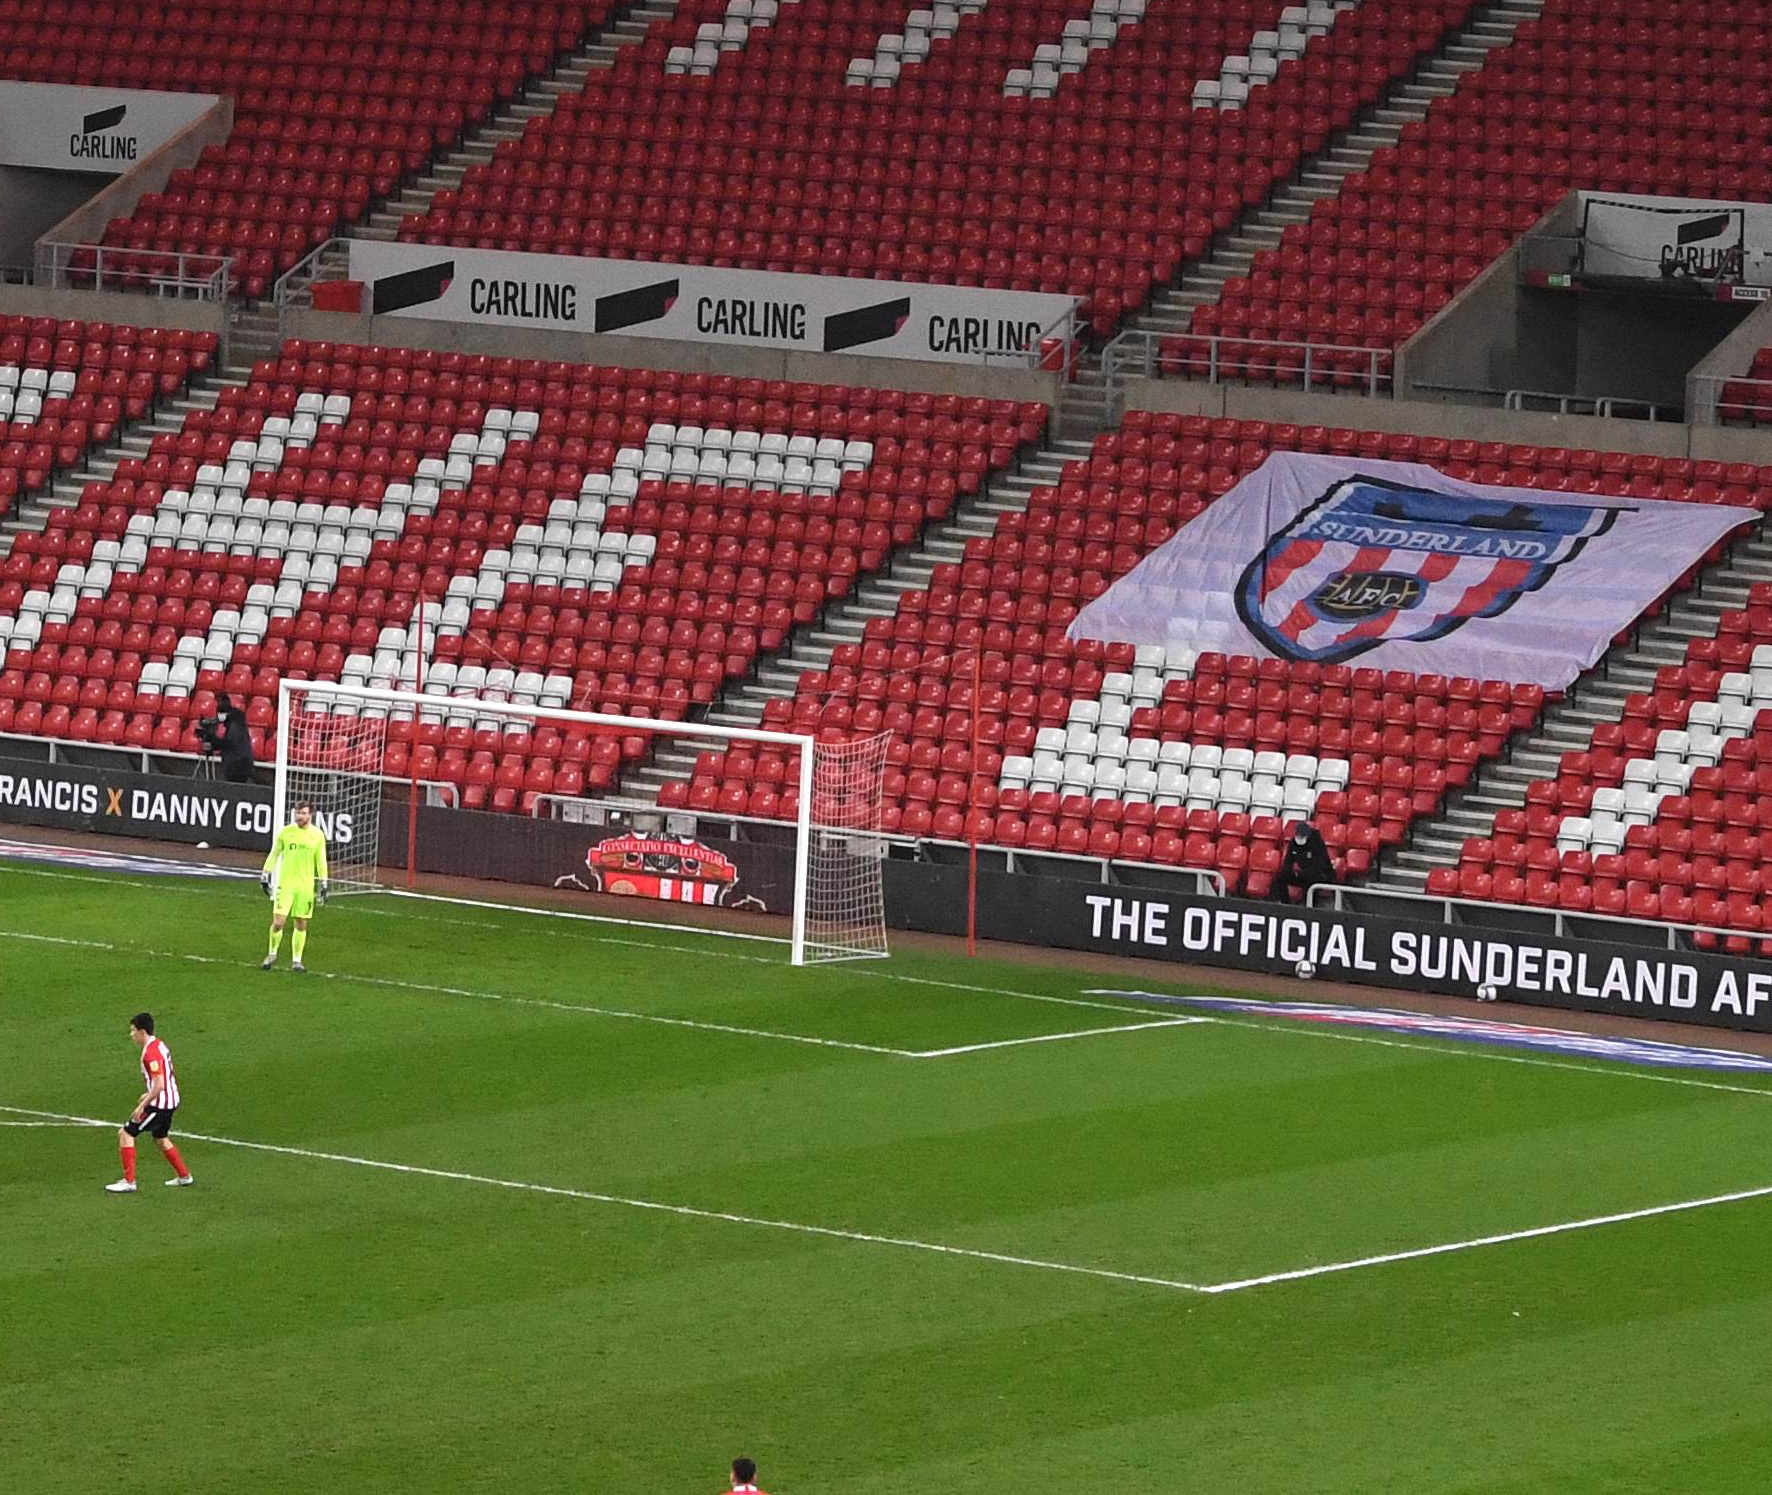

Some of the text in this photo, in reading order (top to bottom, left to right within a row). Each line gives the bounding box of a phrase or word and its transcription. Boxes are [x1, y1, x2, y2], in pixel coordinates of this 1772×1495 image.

[70, 134, 137, 161] CARLING
[470, 279, 576, 321] CARLING
[696, 297, 806, 340] CARLING
[1312, 521, 1547, 561] SUNDERLAND
[1336, 587, 1401, 607] AFC
[130, 789, 228, 830] DANNY
[235, 801, 352, 845] CONS
[602, 840, 661, 854] CONSECTATIO
[1085, 895, 1170, 946] THE
[1183, 907, 1377, 971] OFFICIAL
[1390, 933, 1698, 1010] SUNDERLAND
